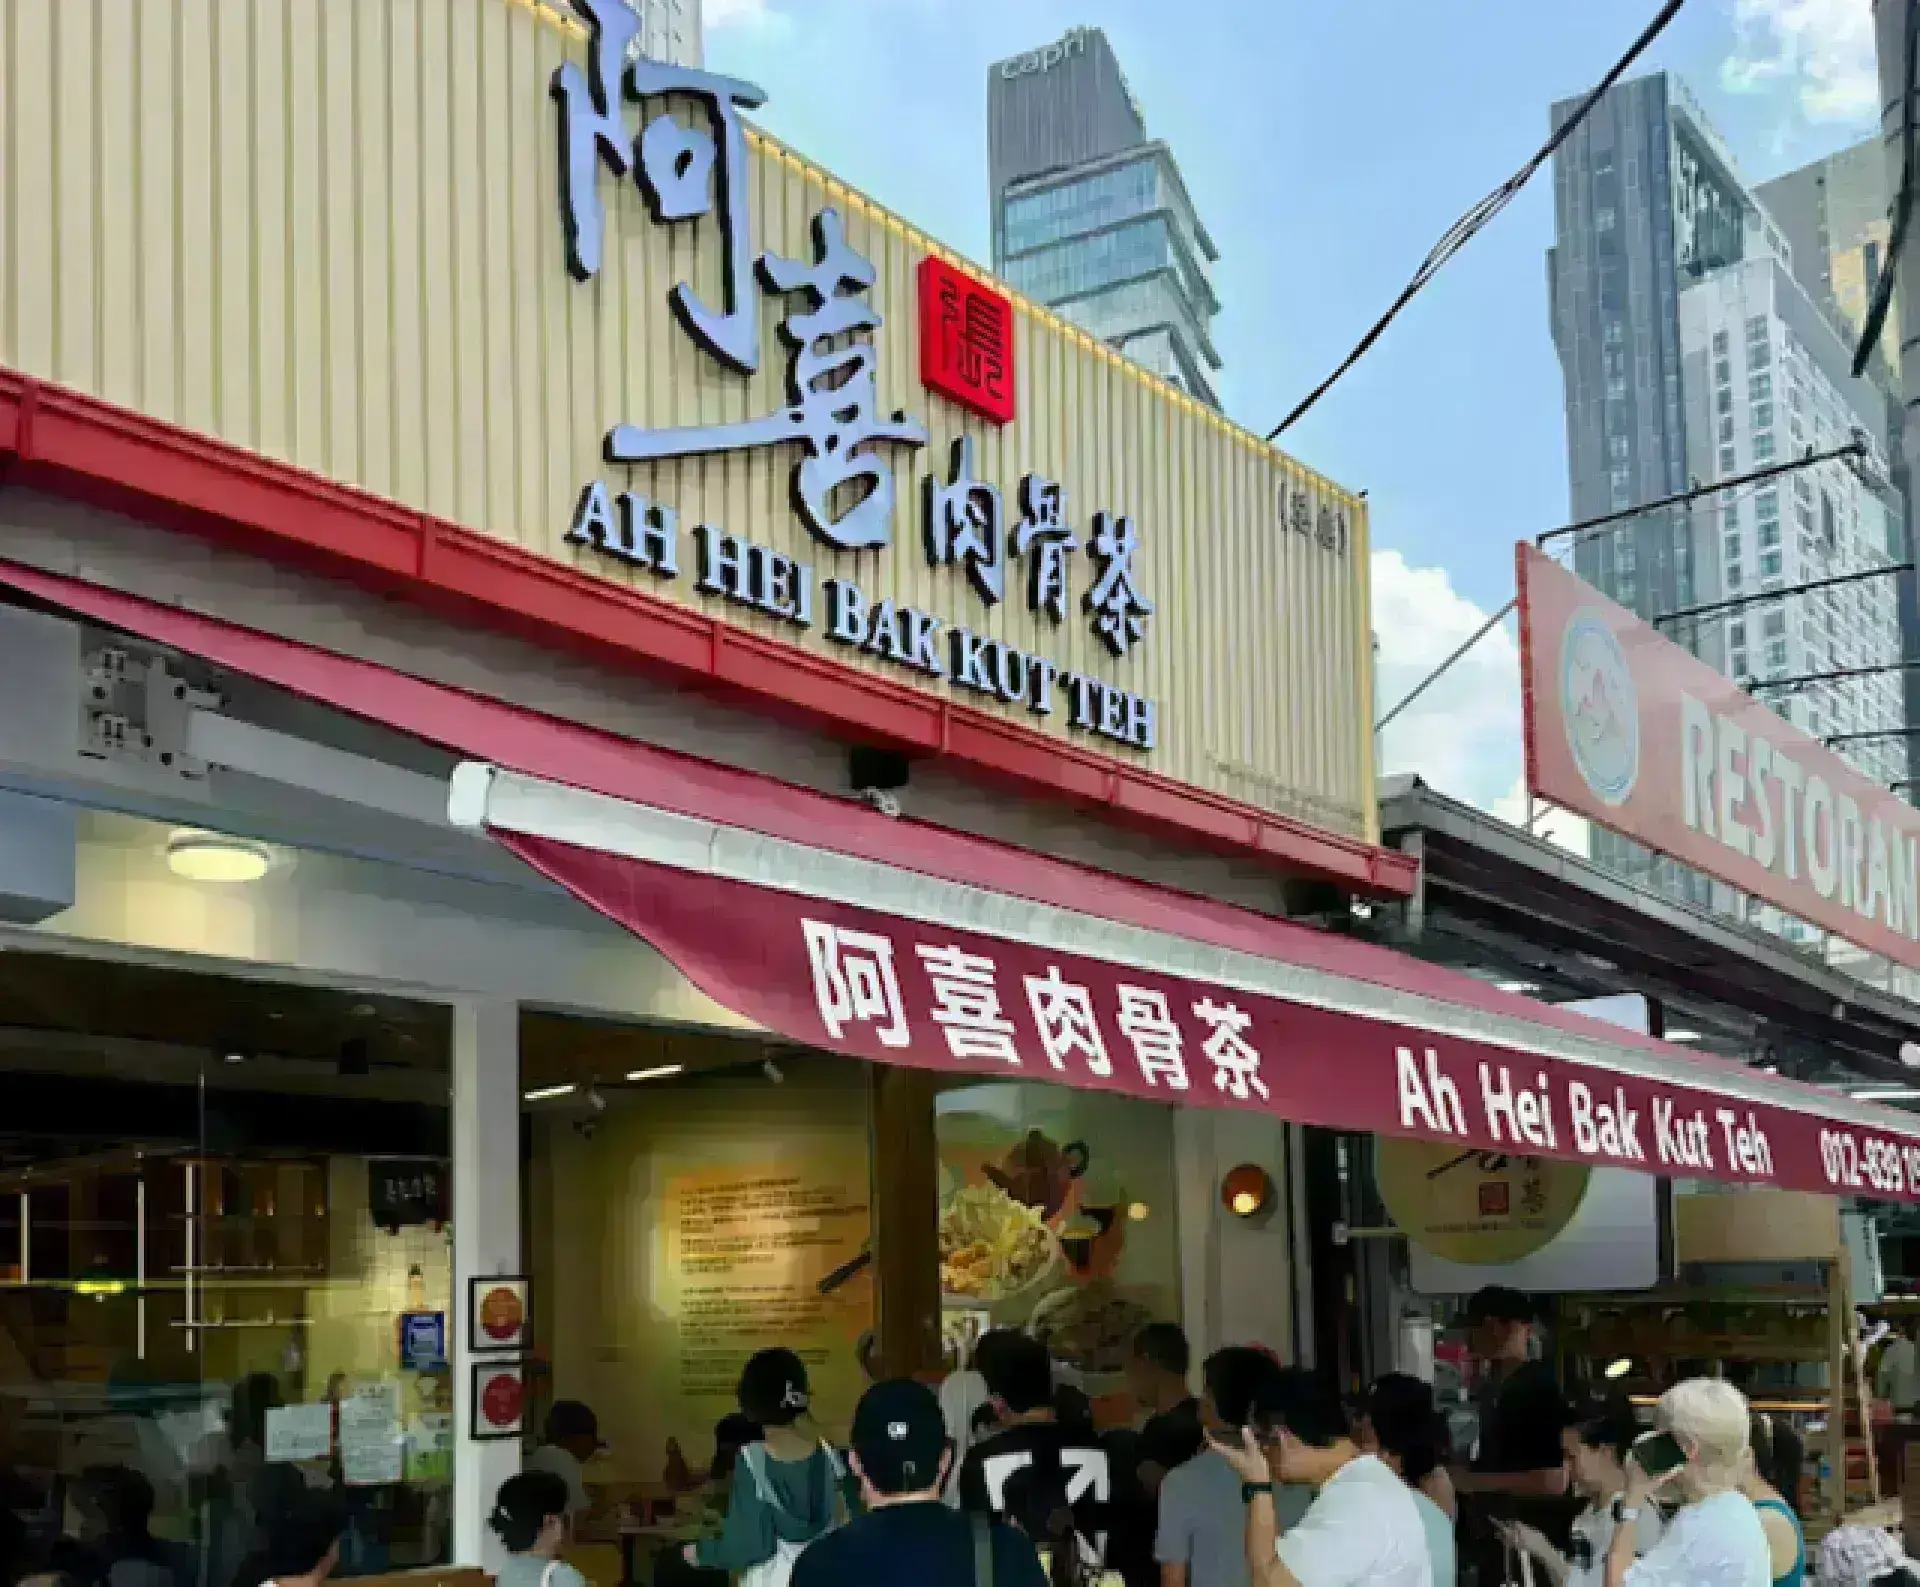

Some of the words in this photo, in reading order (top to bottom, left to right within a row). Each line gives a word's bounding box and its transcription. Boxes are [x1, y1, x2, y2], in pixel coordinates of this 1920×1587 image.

[564, 480, 679, 577] AH
[693, 525, 812, 627] HEI
[822, 579, 945, 677] BAK
[947, 627, 1058, 716] KUT
[1058, 668, 1156, 750] TEH
[922, 434, 1154, 656] 肉骨茶
[1680, 690, 1919, 941] RESTORAN
[800, 917, 1269, 1100] 阿喜肉骨茶
[1395, 1047, 1467, 1136] Ah
[1478, 1062, 1557, 1151] Hei
[1569, 1081, 1645, 1162] Bak
[1652, 1096, 1713, 1171] Kut
[1717, 1109, 1774, 1175] Teh
